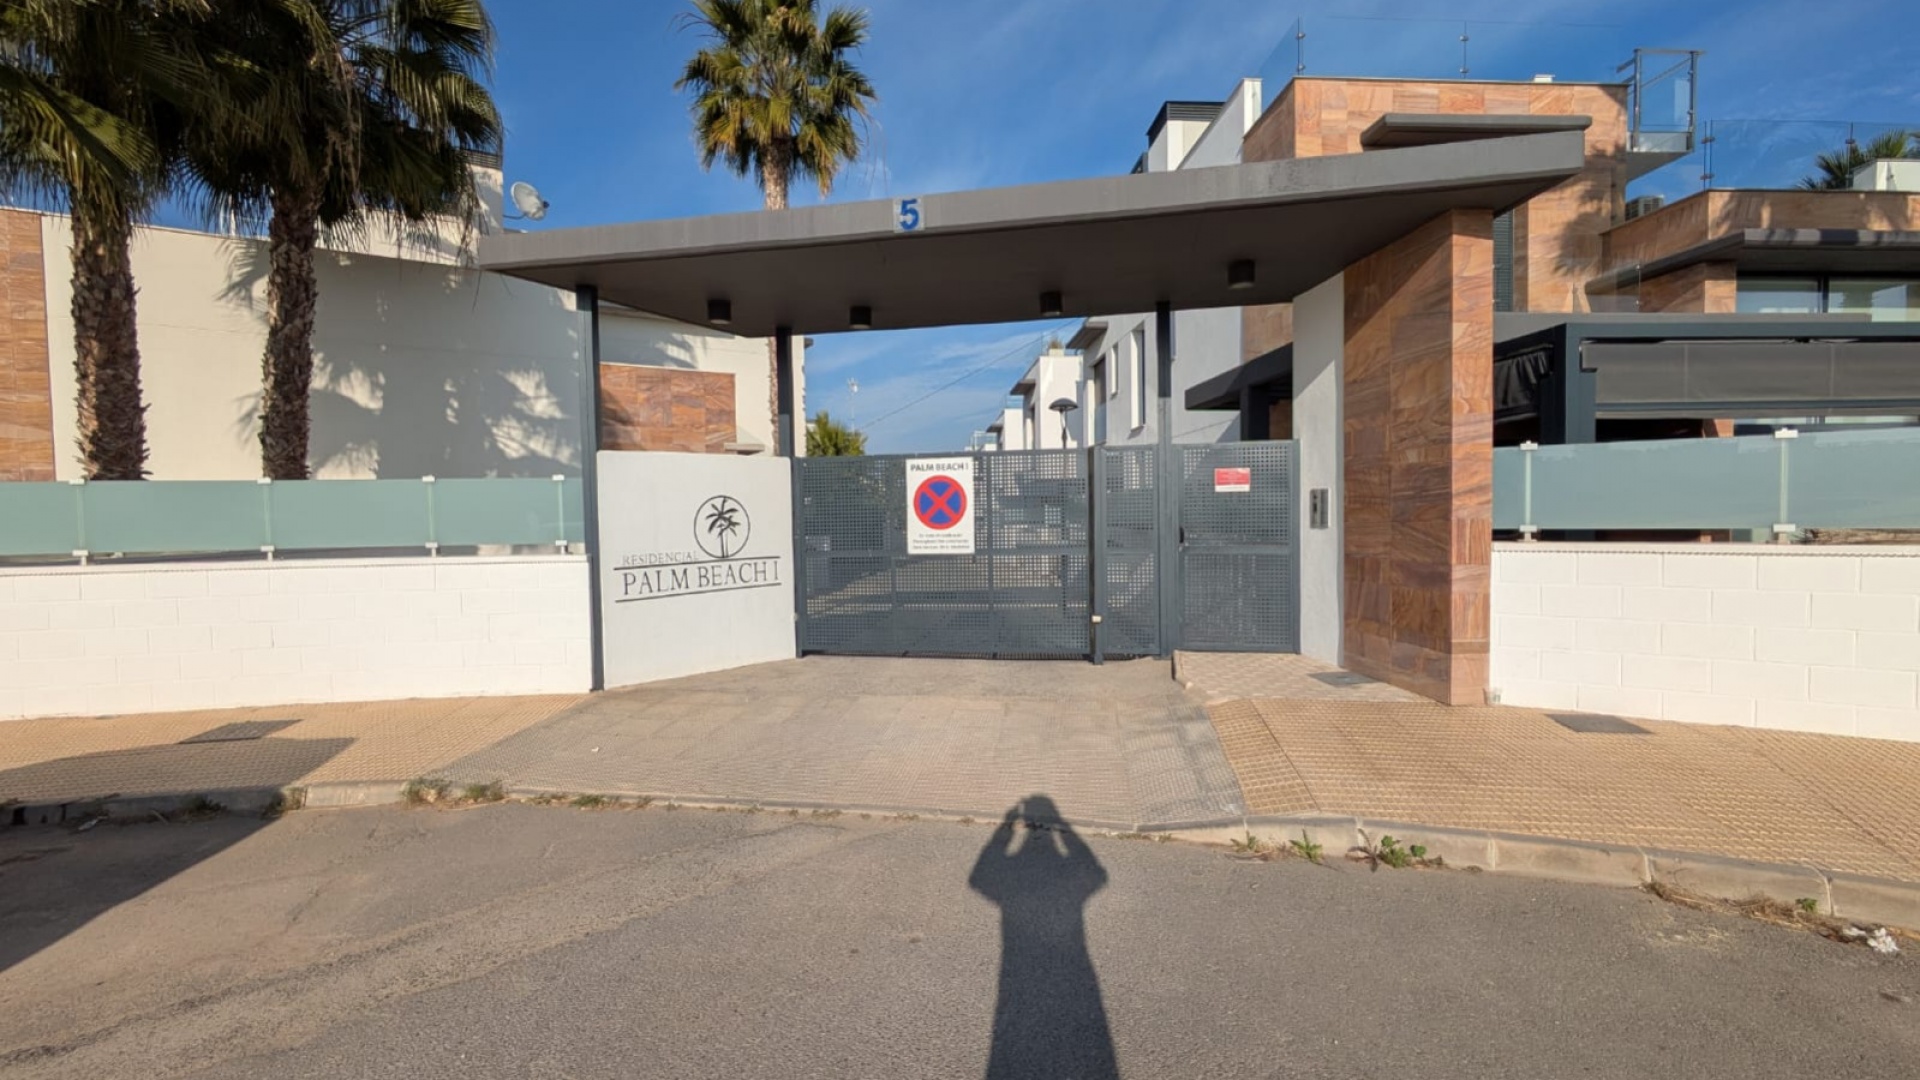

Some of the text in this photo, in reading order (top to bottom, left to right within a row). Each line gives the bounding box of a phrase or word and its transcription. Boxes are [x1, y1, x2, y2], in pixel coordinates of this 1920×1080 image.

[900, 198, 919, 230] 5
[910, 463, 934, 472] PALM
[936, 462, 964, 471] BEACH
[622, 551, 699, 566] RESIDENCIAL
[622, 560, 779, 596] PALM BEACH I
